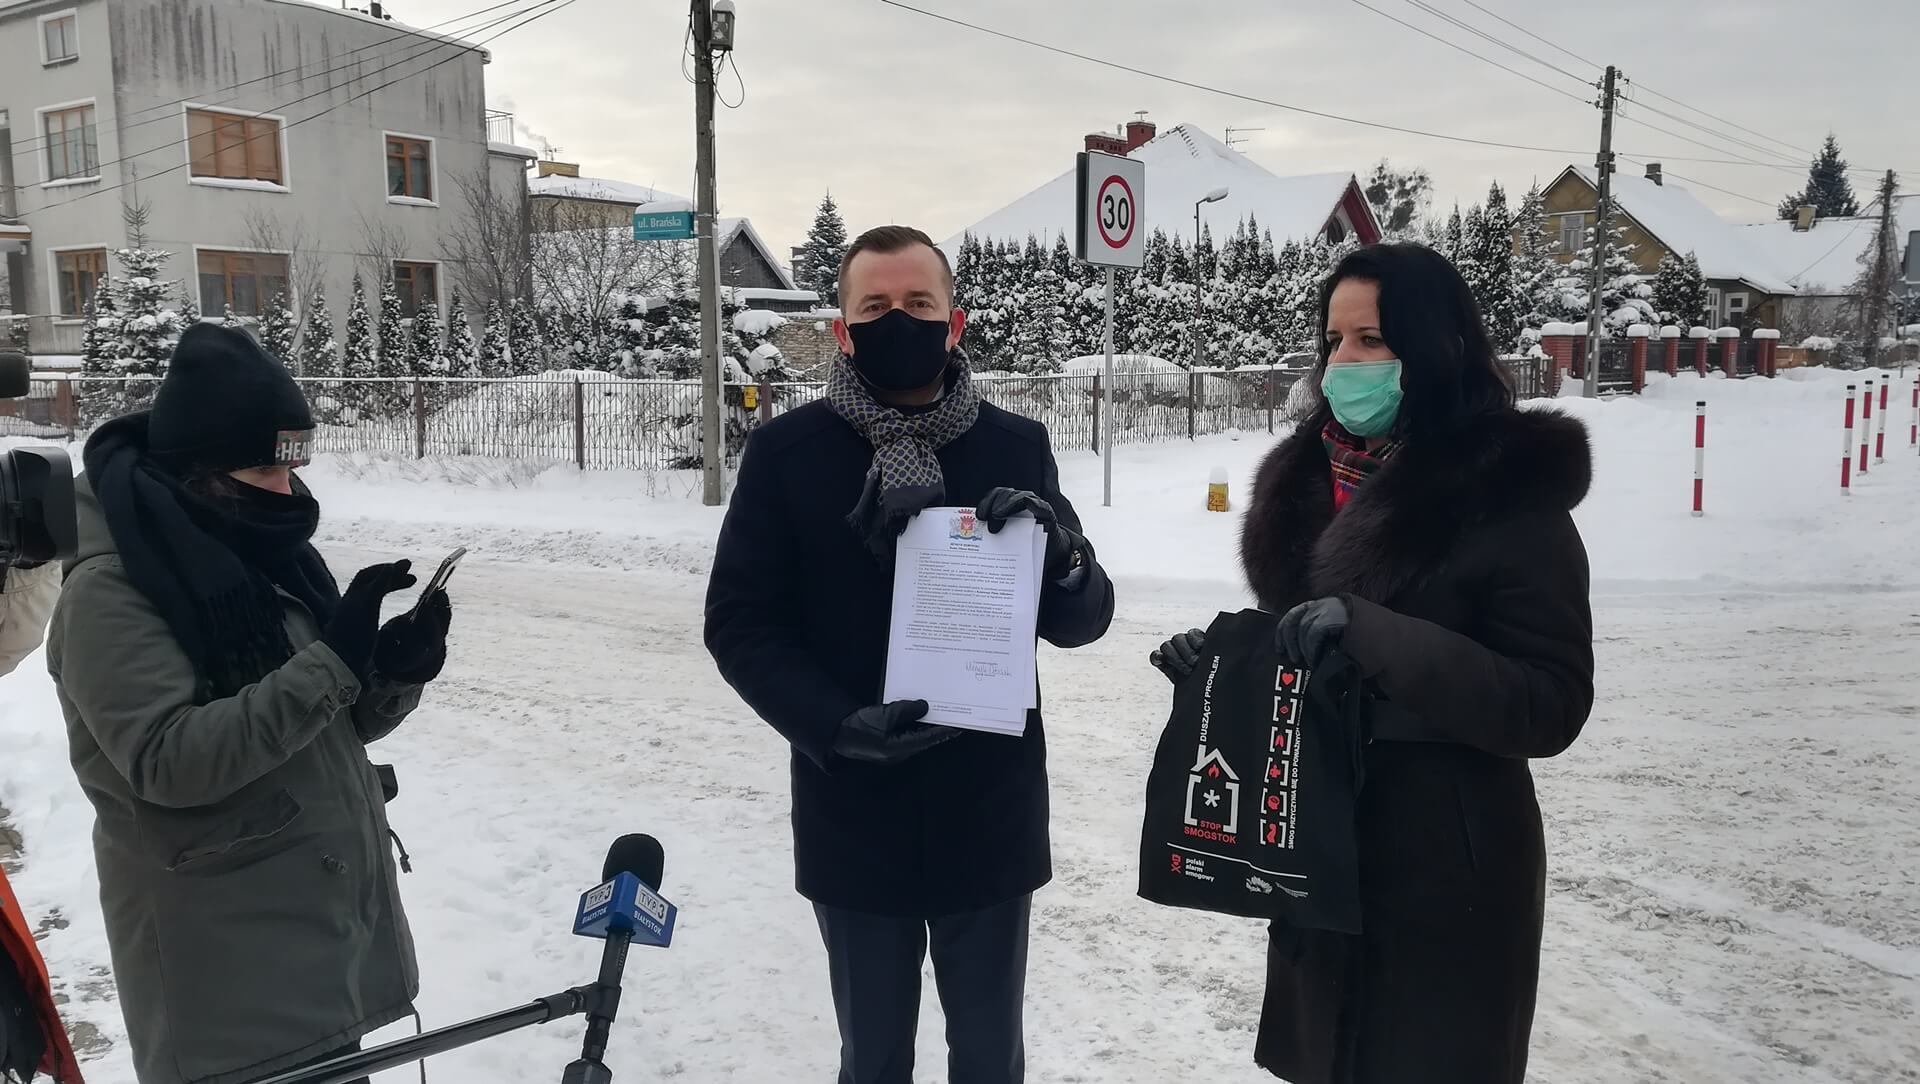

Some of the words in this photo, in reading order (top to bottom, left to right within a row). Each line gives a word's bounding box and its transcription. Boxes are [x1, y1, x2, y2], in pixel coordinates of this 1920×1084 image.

[1103, 194, 1129, 231] 30
[638, 216, 649, 229] ul.
[650, 215, 682, 228] Brańska
[1204, 655, 1220, 698] PROBLEM
[1200, 699, 1211, 742] DUSZĄCY
[1291, 767, 1299, 778] DO
[1200, 820, 1222, 831] STOP
[1183, 826, 1237, 845] SMOGSTOK
[1185, 858, 1205, 867] polski
[1185, 863, 1204, 873] alarm
[1185, 870, 1215, 883] smogowy
